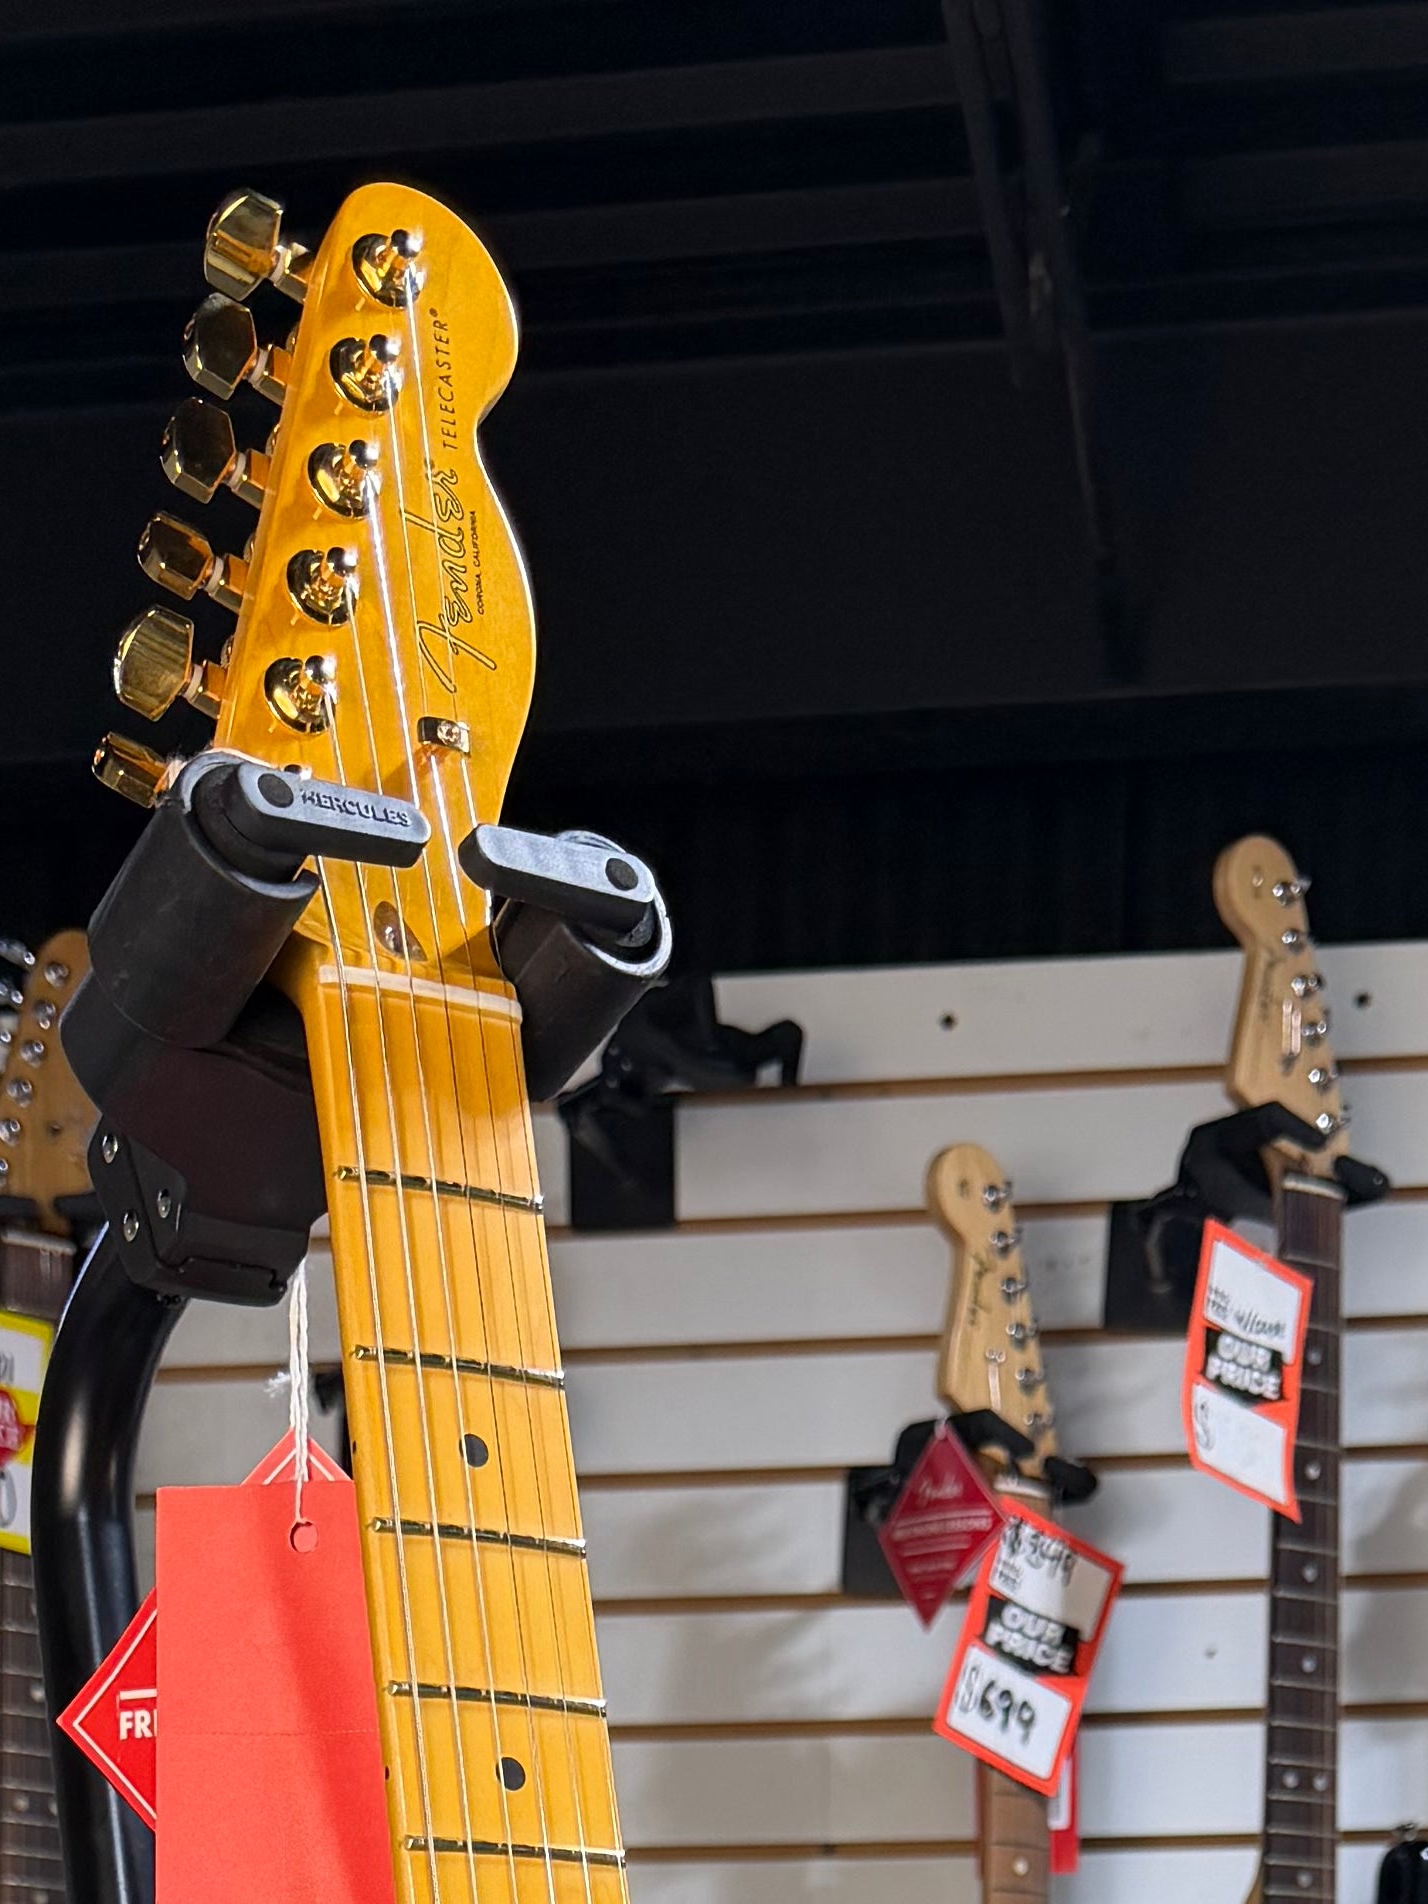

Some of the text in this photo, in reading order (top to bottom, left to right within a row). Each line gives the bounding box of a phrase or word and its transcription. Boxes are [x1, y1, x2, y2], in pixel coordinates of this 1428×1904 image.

[402, 465, 497, 694] Fender
[300, 788, 412, 827] HERCULES
[1217, 1330, 1272, 1371] OUR
[1205, 1352, 1282, 1400] PRICE
[985, 1620, 1073, 1674] PRICE
[1001, 1602, 1067, 1646] OUR
[119, 1709, 157, 1740] FR
[955, 1666, 1037, 1748] $699
